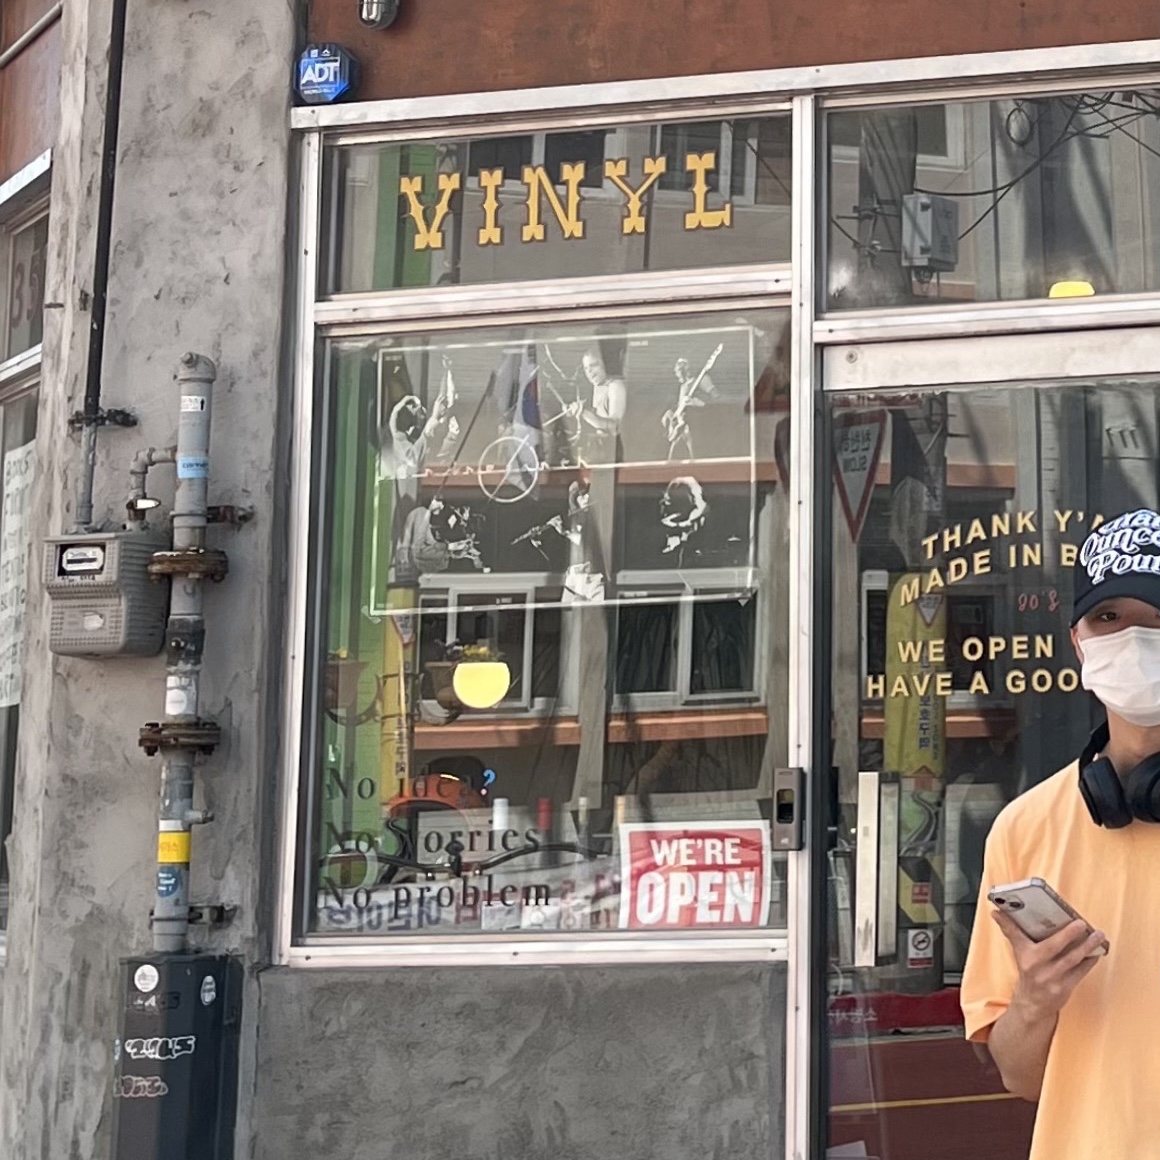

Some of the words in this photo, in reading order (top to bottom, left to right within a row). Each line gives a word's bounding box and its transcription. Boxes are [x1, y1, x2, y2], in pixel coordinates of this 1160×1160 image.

[301, 62, 340, 86] ADT
[400, 151, 733, 252] VINYL
[921, 510, 1037, 561] THANK
[1054, 509, 1104, 534] Y'A
[900, 548, 992, 608] MADE
[1009, 542, 1042, 568] IN
[898, 639, 945, 664] WE
[962, 634, 1054, 662] OPEN
[867, 671, 953, 698] HAVE
[969, 670, 990, 695] A
[1006, 668, 1079, 694] GOO
[325, 767, 376, 800] No
[650, 838, 742, 867] WE'RE
[324, 876, 372, 909] No
[393, 873, 551, 919] problem
[635, 870, 756, 925] OPEN
